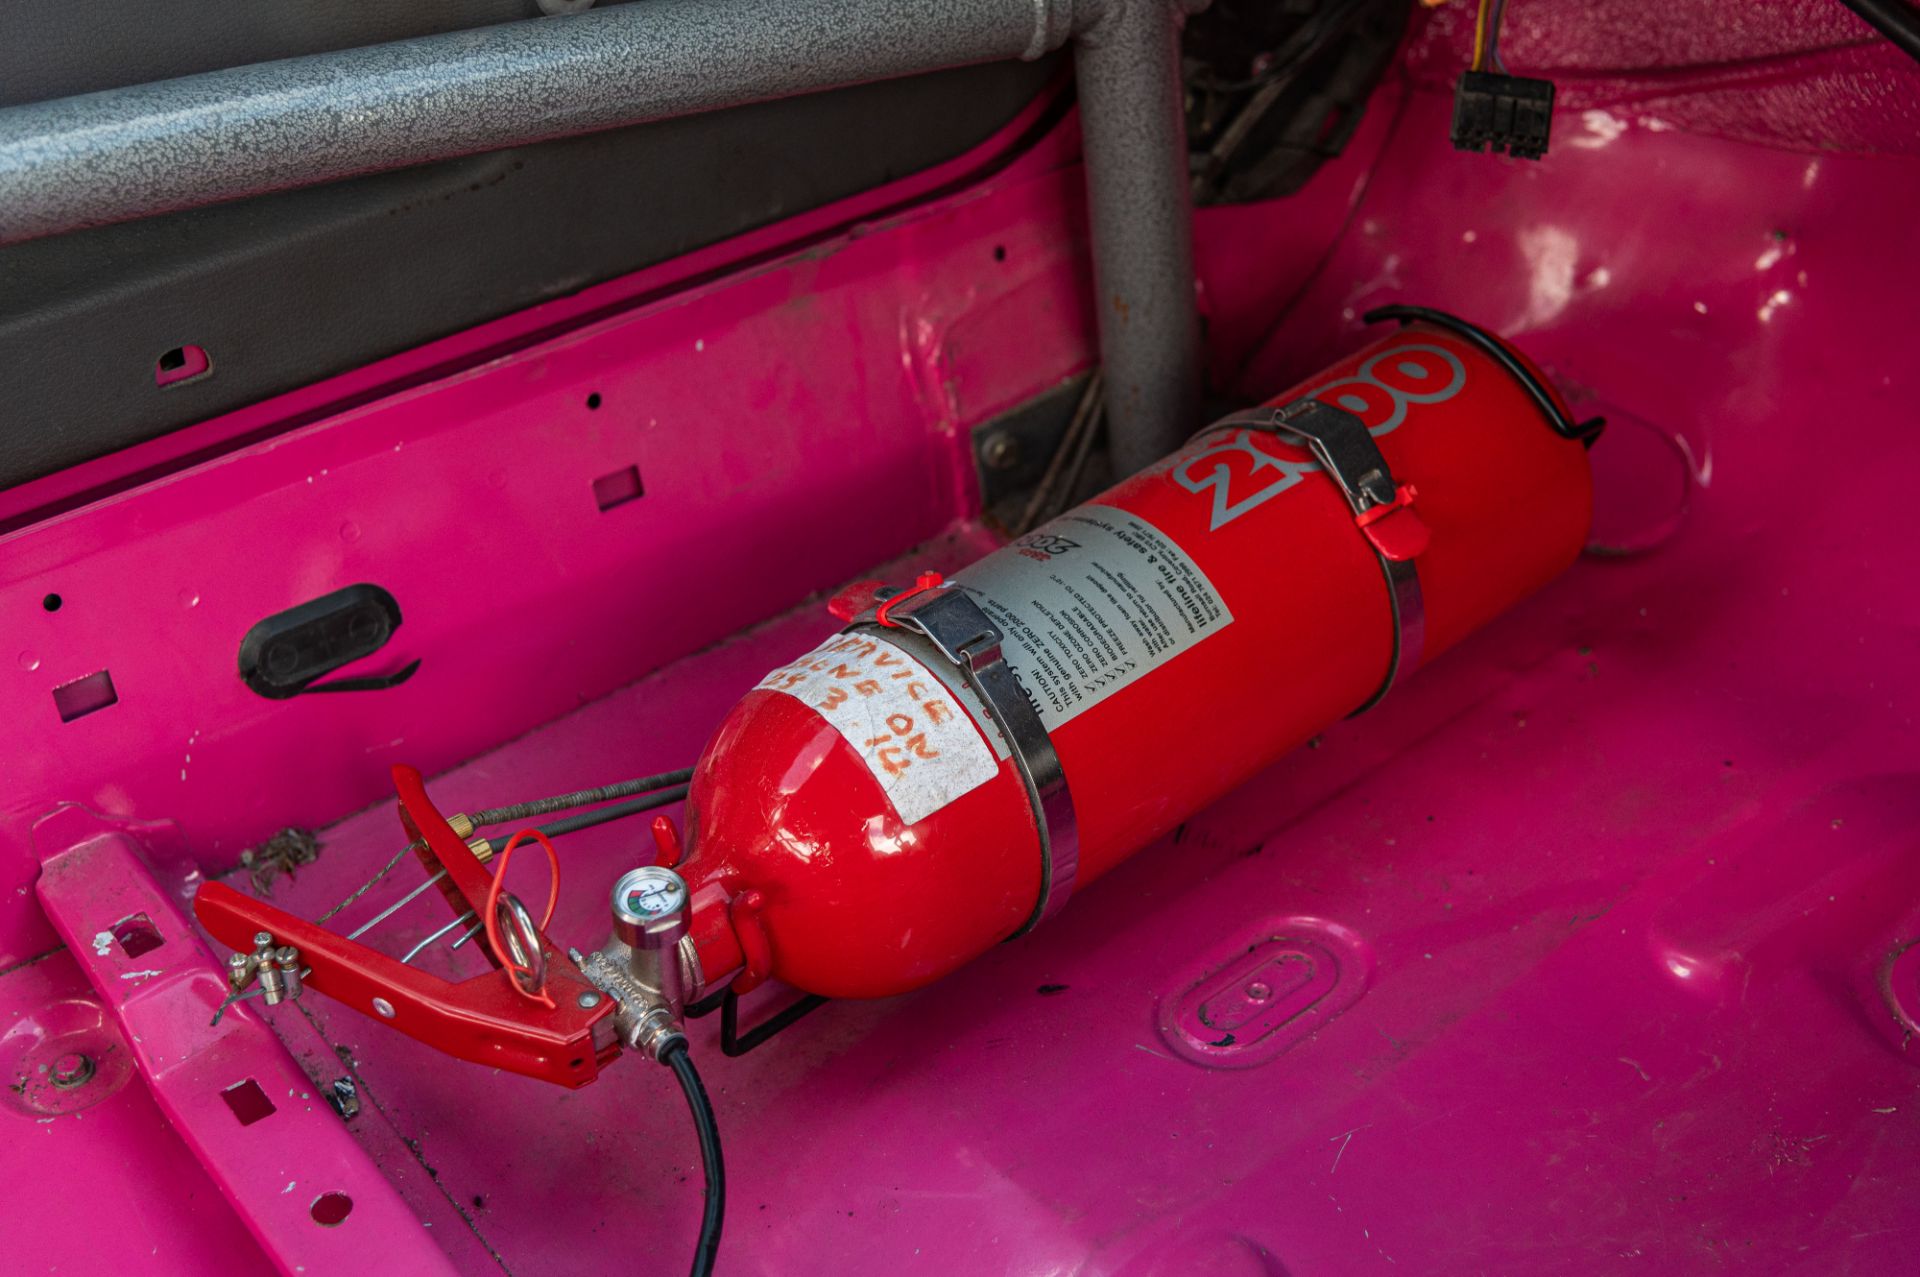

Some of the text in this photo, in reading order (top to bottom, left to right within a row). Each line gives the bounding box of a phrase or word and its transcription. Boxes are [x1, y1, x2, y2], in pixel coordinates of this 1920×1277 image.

[1113, 530, 1148, 554] safety
[1146, 554, 1158, 564] &
[1157, 564, 1177, 584] fire
[1064, 585, 1075, 594] TO
[1106, 593, 1118, 605] like
[1125, 591, 1134, 600] to
[1136, 593, 1146, 604] for
[1202, 591, 1214, 605] 024
[1073, 592, 1109, 629] PROTECTED
[1116, 603, 1131, 621] foam
[1132, 599, 1149, 619] return
[1162, 589, 1195, 634] Manufactured
[1175, 585, 1207, 628] lifeline
[1004, 611, 1026, 628] 2000
[1129, 620, 1144, 637] away
[1144, 603, 1170, 636] distributor
[1147, 618, 1158, 632] use
[1007, 626, 1025, 642] only
[1021, 626, 1045, 649] ZERO
[1031, 599, 1098, 673] ZERO OZONE DEPLETION
[1059, 609, 1108, 668] ZERO CORROSION
[1071, 606, 1118, 661] BIODEGRADABLE
[1105, 627, 1128, 656] FREEZE
[1156, 632, 1169, 649] After
[1167, 637, 1176, 646] or
[1021, 641, 1037, 656] will
[1047, 630, 1088, 679] ZERO TOXICITY
[1142, 637, 1156, 658] Wash
[1151, 637, 1162, 653] with
[1036, 655, 1061, 686] system
[1043, 648, 1071, 681] genuine
[1030, 668, 1064, 713] CAUTION!
[1058, 686, 1073, 708] This
[1068, 681, 1083, 702] with
[886, 713, 941, 759] ON
